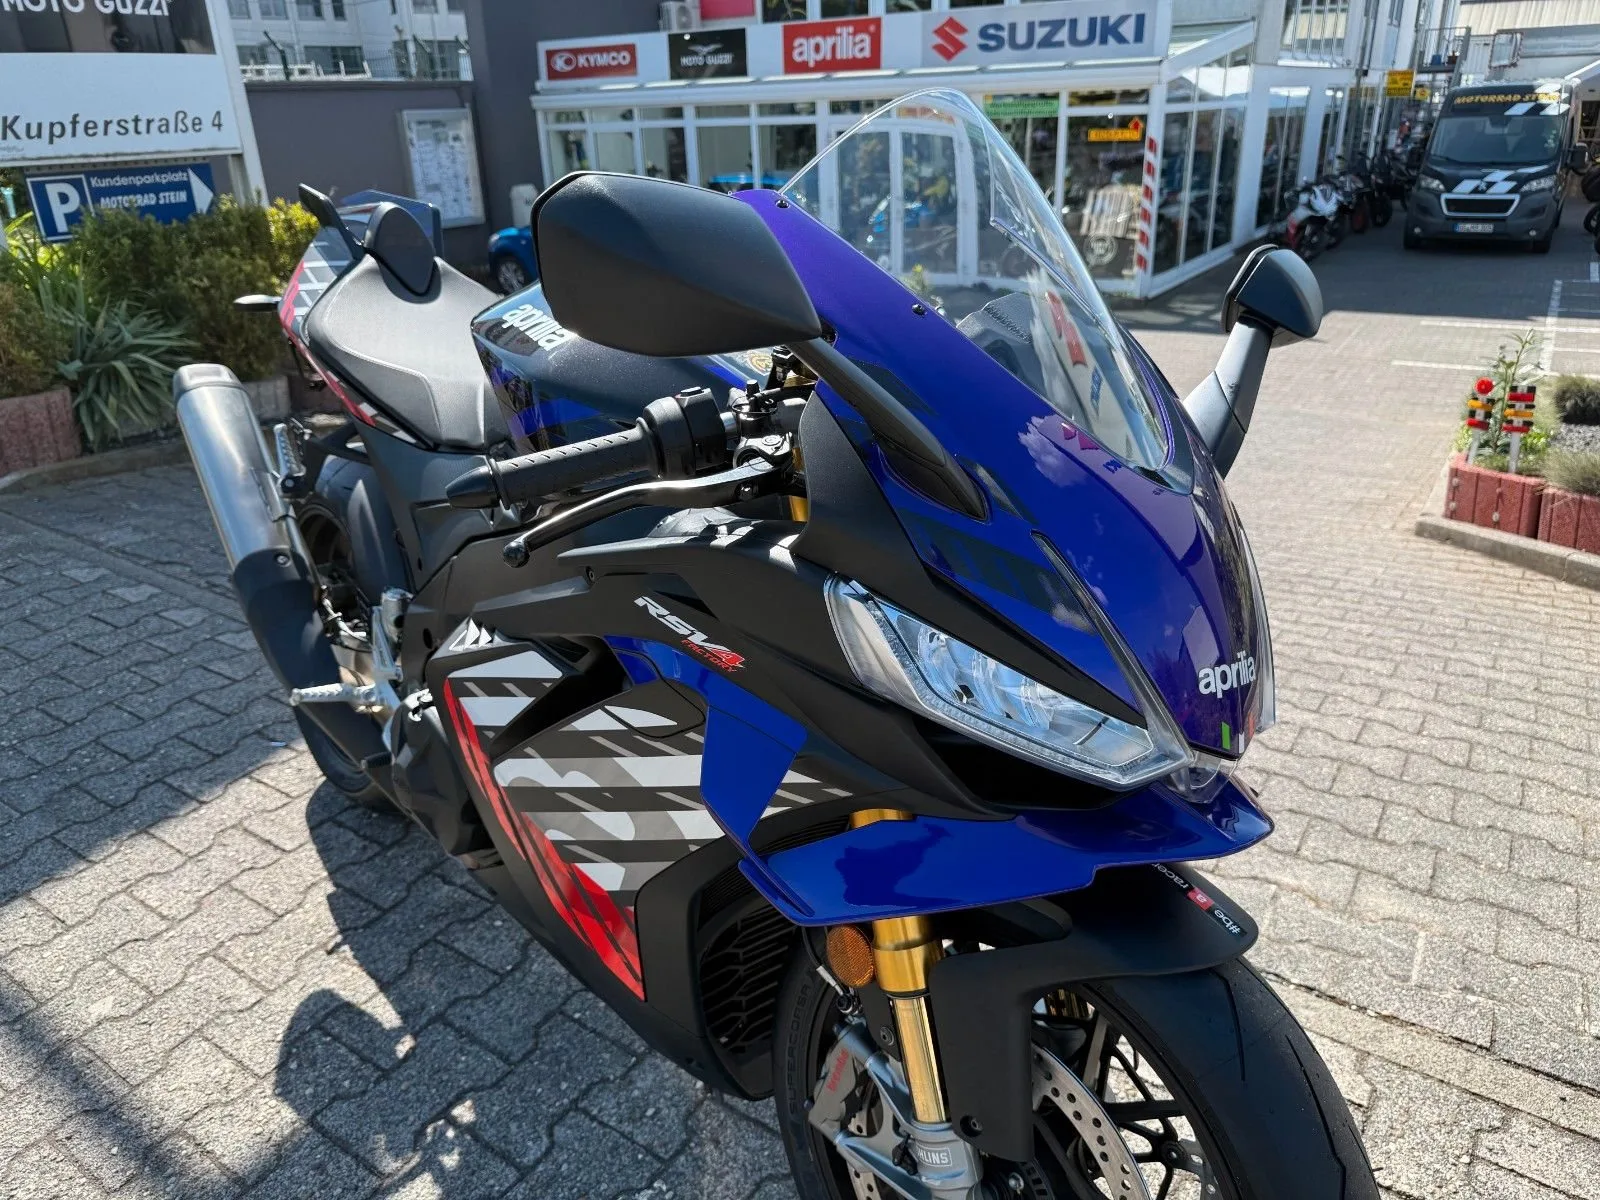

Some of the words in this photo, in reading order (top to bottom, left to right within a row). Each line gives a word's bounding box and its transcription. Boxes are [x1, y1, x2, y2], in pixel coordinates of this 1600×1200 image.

[2, 0, 85, 13] MOTO
[792, 26, 871, 68] aprilia
[977, 13, 1145, 53] SUZUKI
[577, 51, 631, 68] KYMCO
[680, 55, 704, 66] MOTO
[706, 53, 733, 65] GUZZI
[1454, 94, 1521, 104] MOTORRAD
[1, 111, 203, 145] Kupferstraße
[211, 111, 224, 132] 4
[90, 171, 188, 188] Kundenparkplatz
[44, 182, 80, 233] P
[158, 190, 187, 204] STEIN
[501, 303, 578, 351] aprilia
[634, 596, 745, 668] RSV4
[681, 639, 737, 672] FACTORY
[1199, 651, 1256, 698] aprilia
[1152, 863, 1189, 889] racer
[1214, 909, 1241, 935] #be
[786, 984, 811, 1117] SUPERCORSA
[917, 1147, 949, 1164] HLINS
